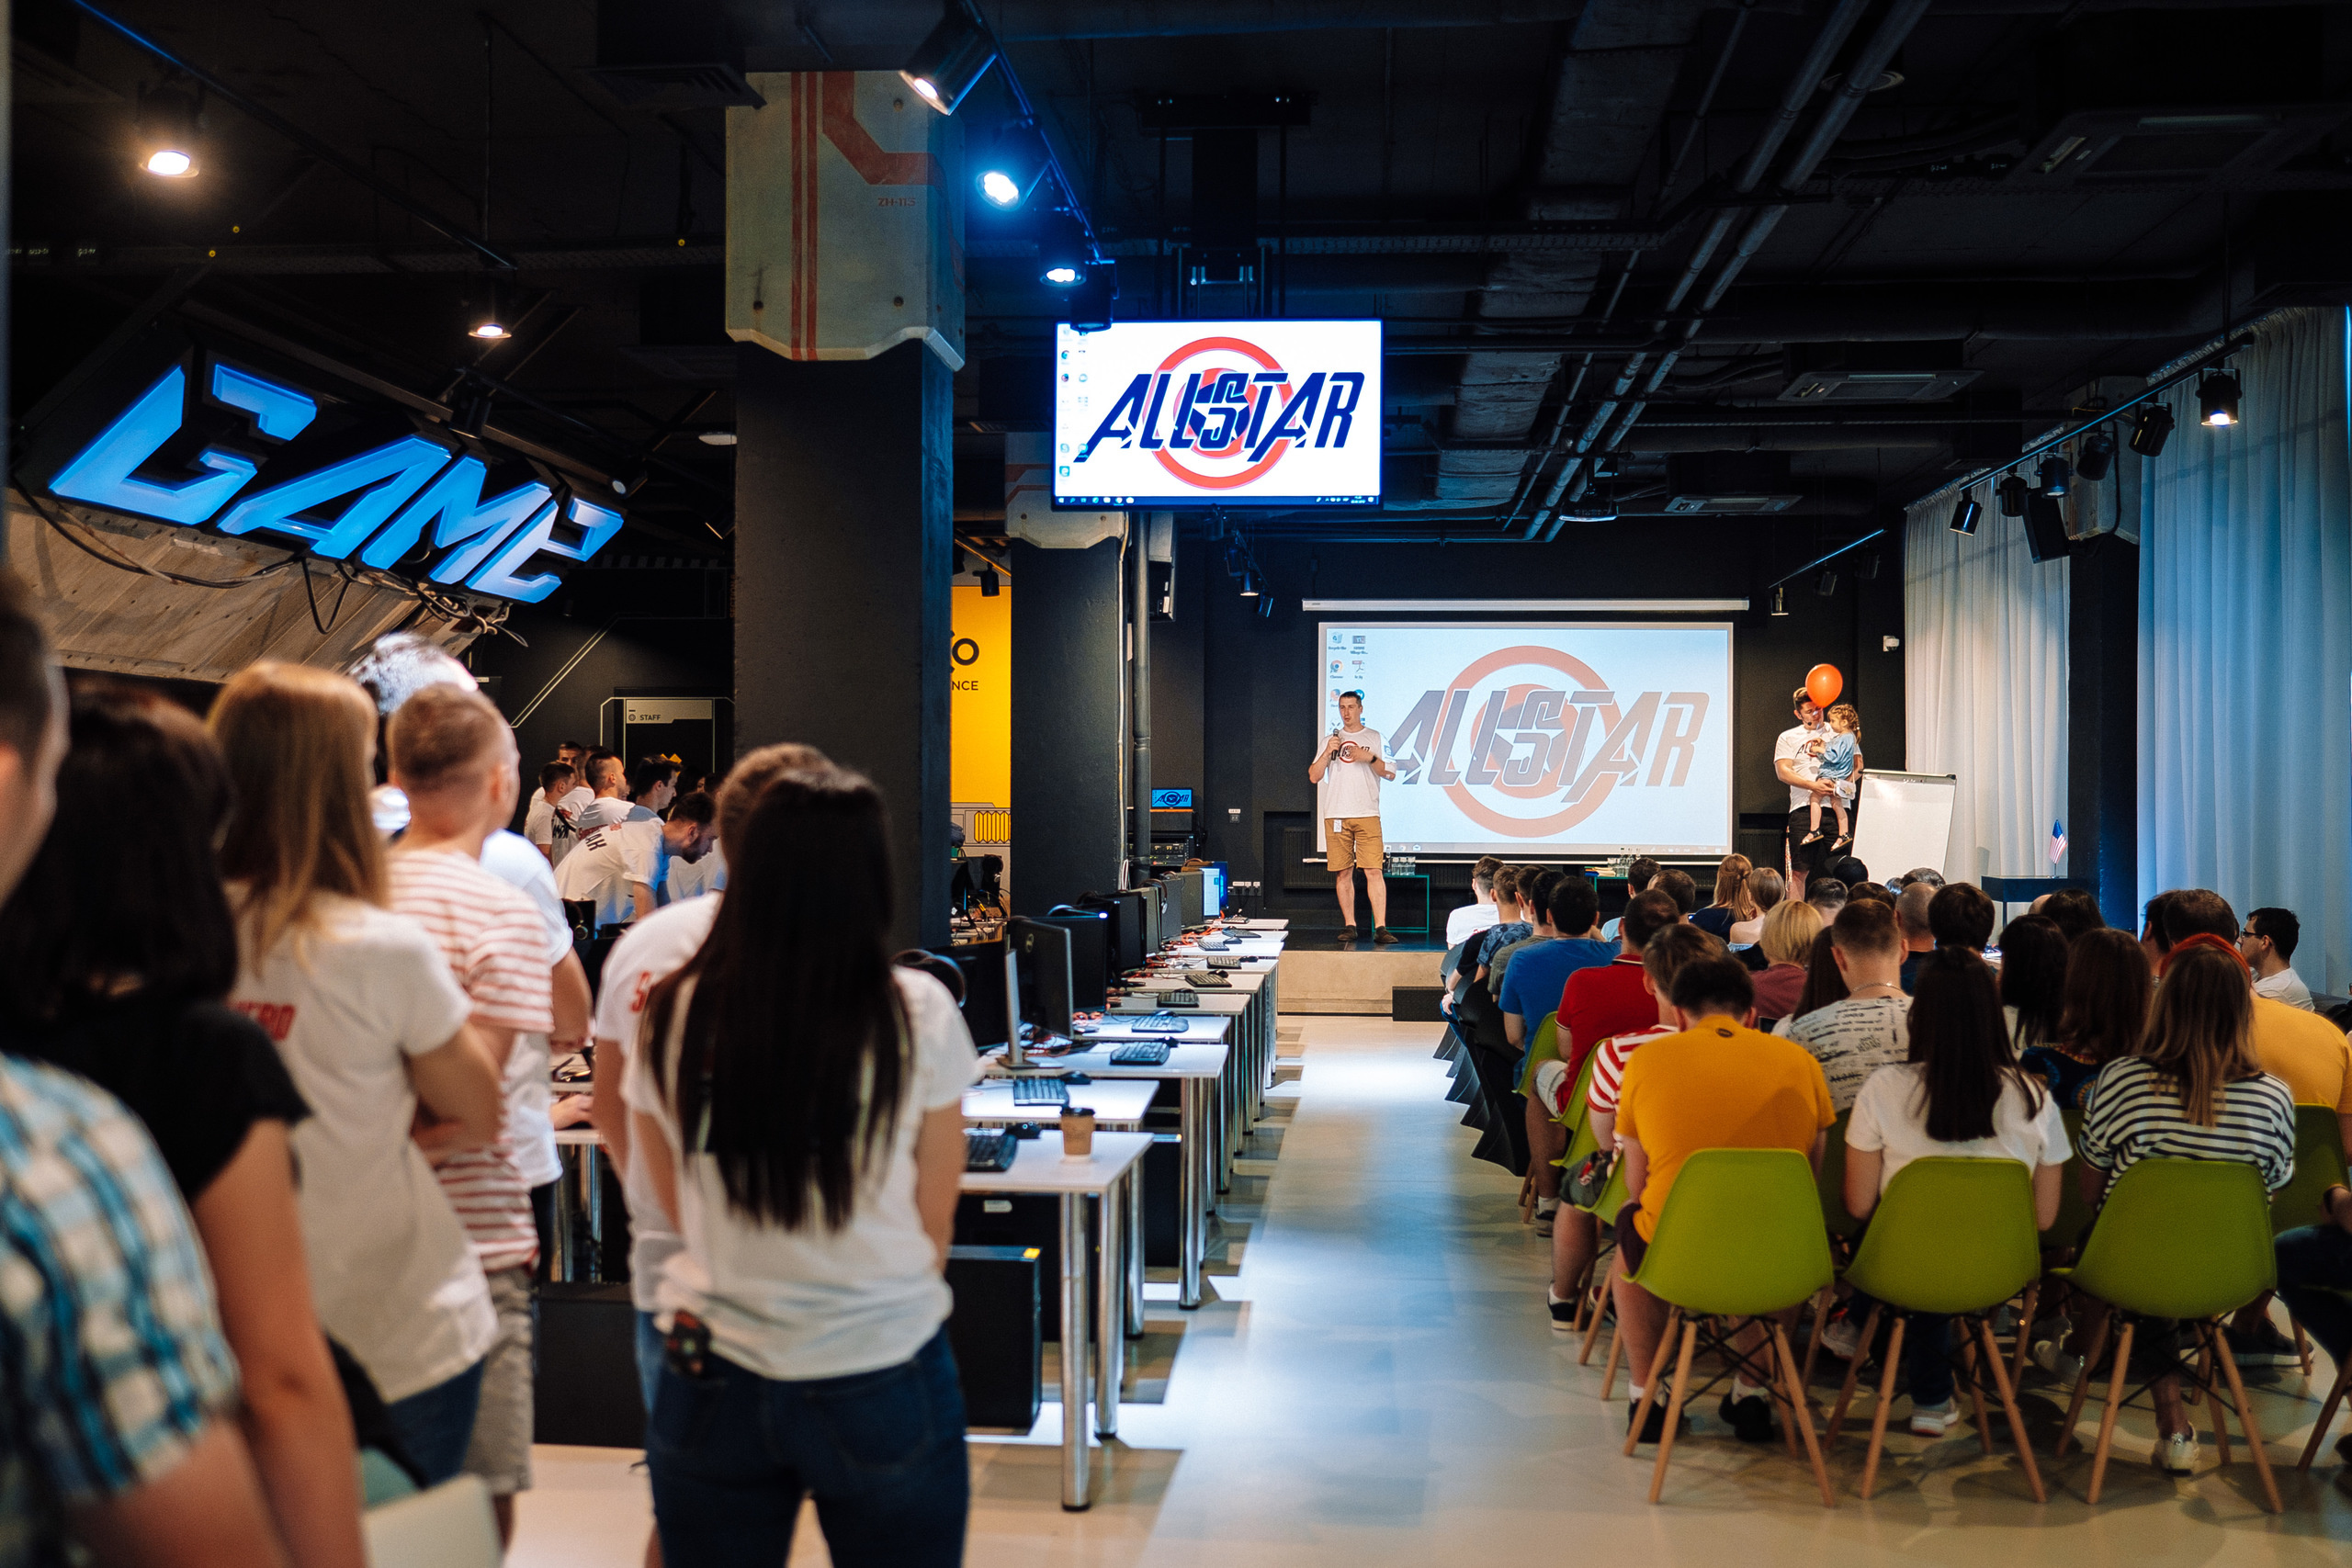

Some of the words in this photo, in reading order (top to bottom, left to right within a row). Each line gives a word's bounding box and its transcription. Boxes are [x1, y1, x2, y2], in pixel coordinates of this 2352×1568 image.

[1072, 371, 1365, 463] ALLSTAR
[49, 364, 625, 604] GAME
[951, 680, 978, 691] NCE
[1386, 689, 1710, 804] ALLSTAR
